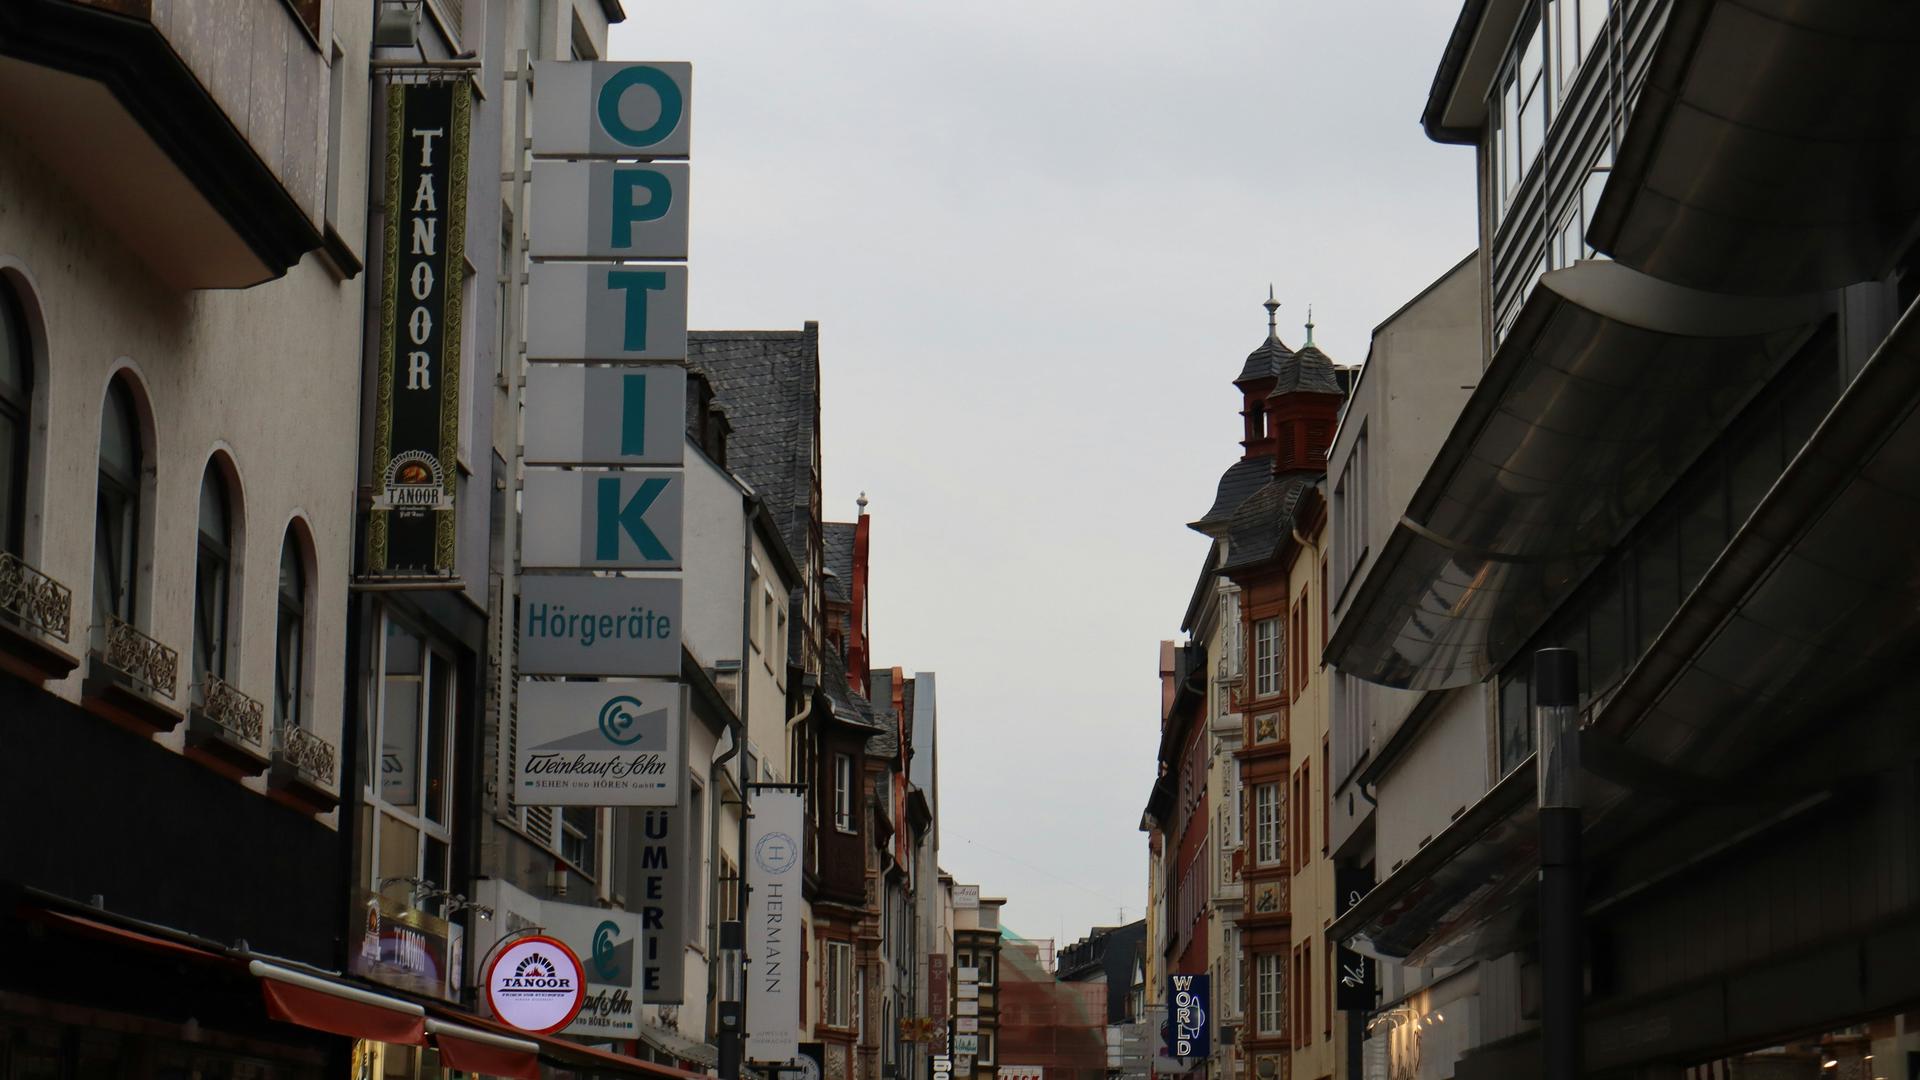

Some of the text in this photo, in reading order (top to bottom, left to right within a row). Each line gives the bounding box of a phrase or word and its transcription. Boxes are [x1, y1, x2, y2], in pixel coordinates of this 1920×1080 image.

[406, 127, 443, 390] TANOOR
[596, 65, 682, 561] OPTIK
[387, 489, 438, 503] TANOOR
[528, 603, 671, 646] Hörgeräte
[536, 780, 569, 788] SEHEN
[593, 779, 628, 788] HÖREN
[642, 811, 668, 990] ÜMERIE
[765, 884, 783, 993] HERMANN
[502, 978, 570, 988] TANOOR
[1173, 976, 1192, 1056] WORLD
